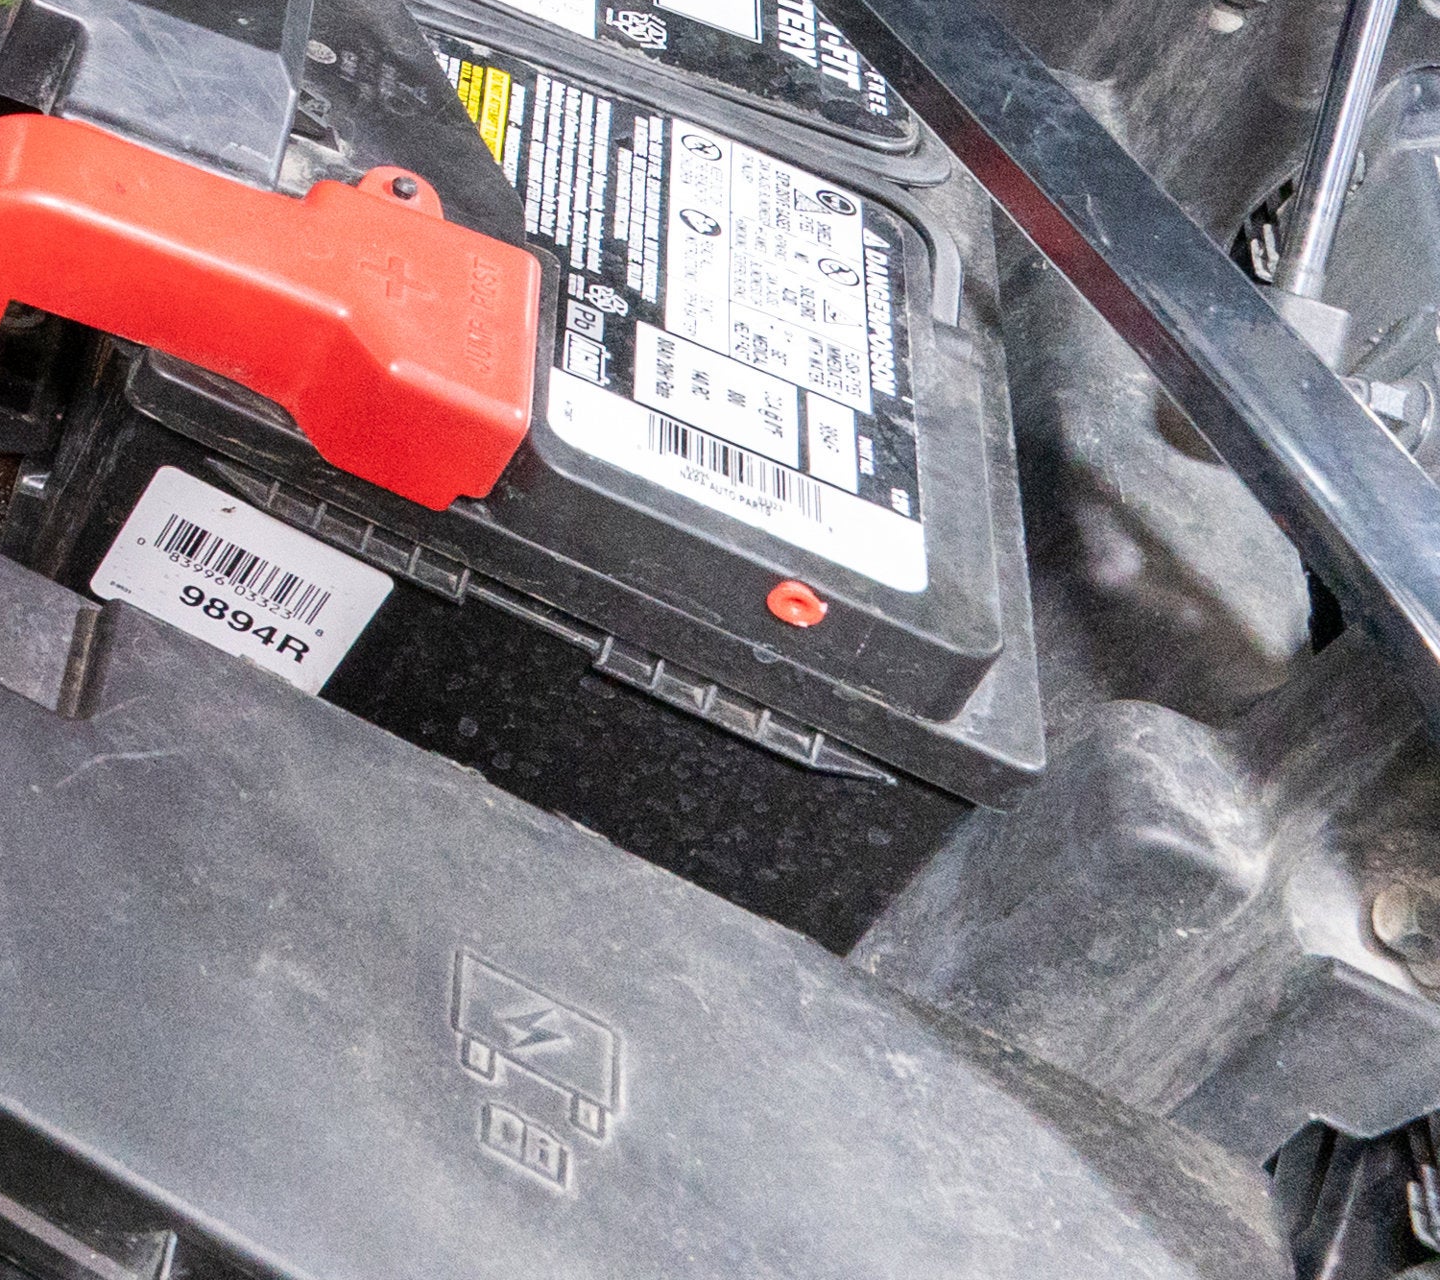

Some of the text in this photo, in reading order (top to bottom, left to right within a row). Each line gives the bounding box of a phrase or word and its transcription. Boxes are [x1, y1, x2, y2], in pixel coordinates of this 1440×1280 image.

[573, 305, 595, 334] Pb
[864, 246, 894, 396] DANGER/POISON
[680, 468, 708, 488] NAPA
[710, 483, 737, 502] AUTO
[136, 536, 324, 637] 0 83996 03323 8
[178, 584, 311, 664] 9894R
